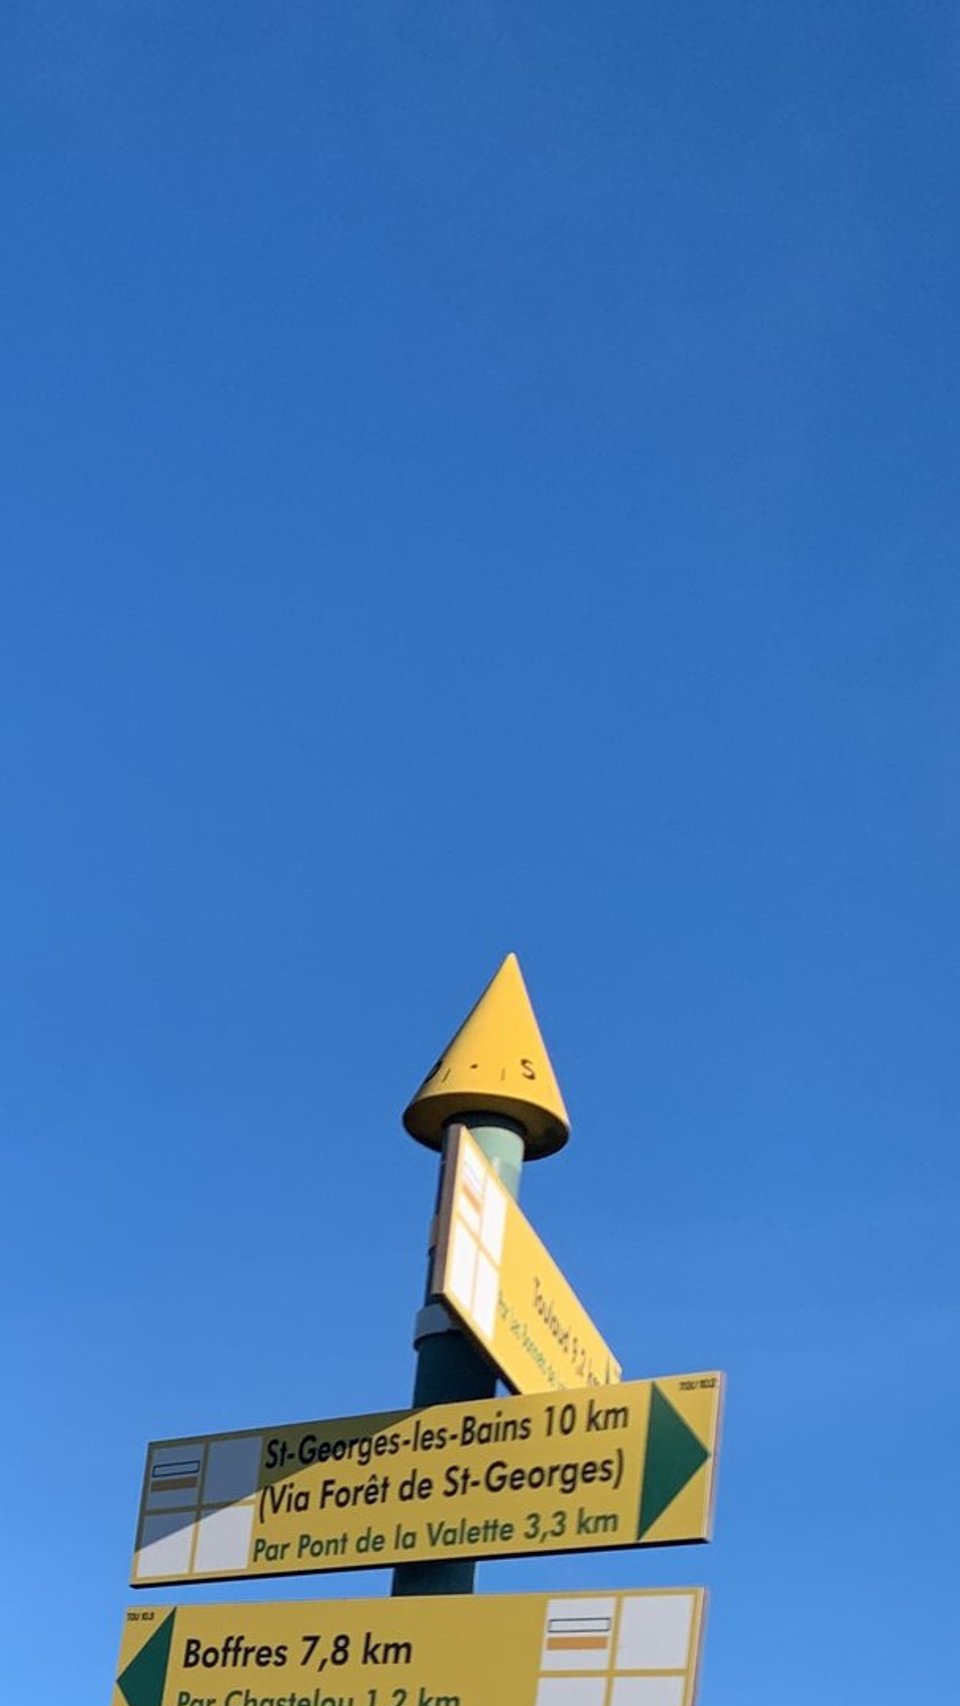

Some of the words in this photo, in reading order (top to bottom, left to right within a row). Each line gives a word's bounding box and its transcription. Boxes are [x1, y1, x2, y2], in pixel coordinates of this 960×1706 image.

[265, 1410, 532, 1469] St-Georges-les-Bains
[544, 1403, 577, 1437] 10
[585, 1398, 630, 1432] km
[259, 1482, 311, 1524] (Via
[319, 1474, 389, 1509] Forêt
[398, 1468, 433, 1501] de
[442, 1448, 625, 1497] St-Georges)
[253, 1538, 291, 1562] Par
[297, 1532, 348, 1558] Pont
[356, 1526, 385, 1553] de
[394, 1523, 417, 1550] la
[426, 1517, 515, 1548] Valette
[524, 1510, 567, 1543] 3,3
[576, 1507, 620, 1536] km
[182, 1635, 289, 1668] Boffres
[300, 1634, 350, 1672] 7,8
[362, 1632, 413, 1665] km
